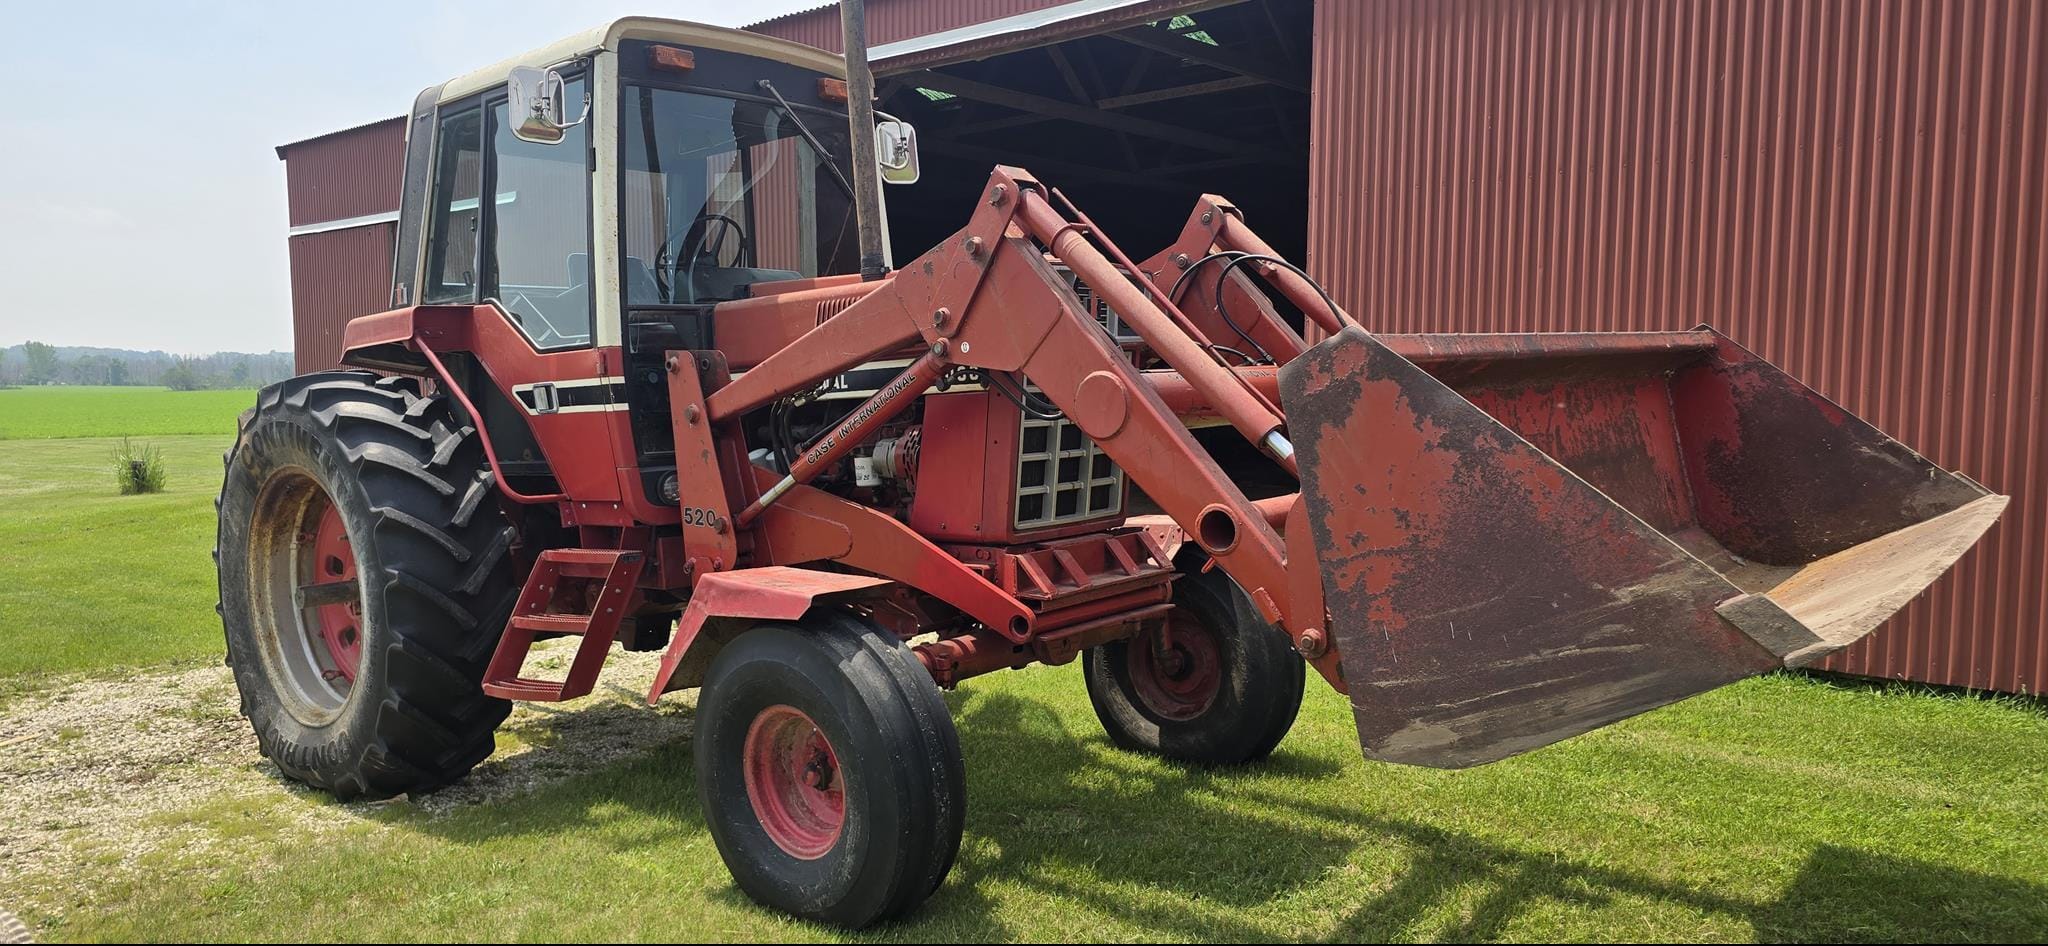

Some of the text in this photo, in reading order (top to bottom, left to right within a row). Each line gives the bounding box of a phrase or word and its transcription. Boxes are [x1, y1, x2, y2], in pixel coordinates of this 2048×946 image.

[807, 371, 917, 465] CASE INTERNATIONAL
[684, 507, 716, 527] 520
